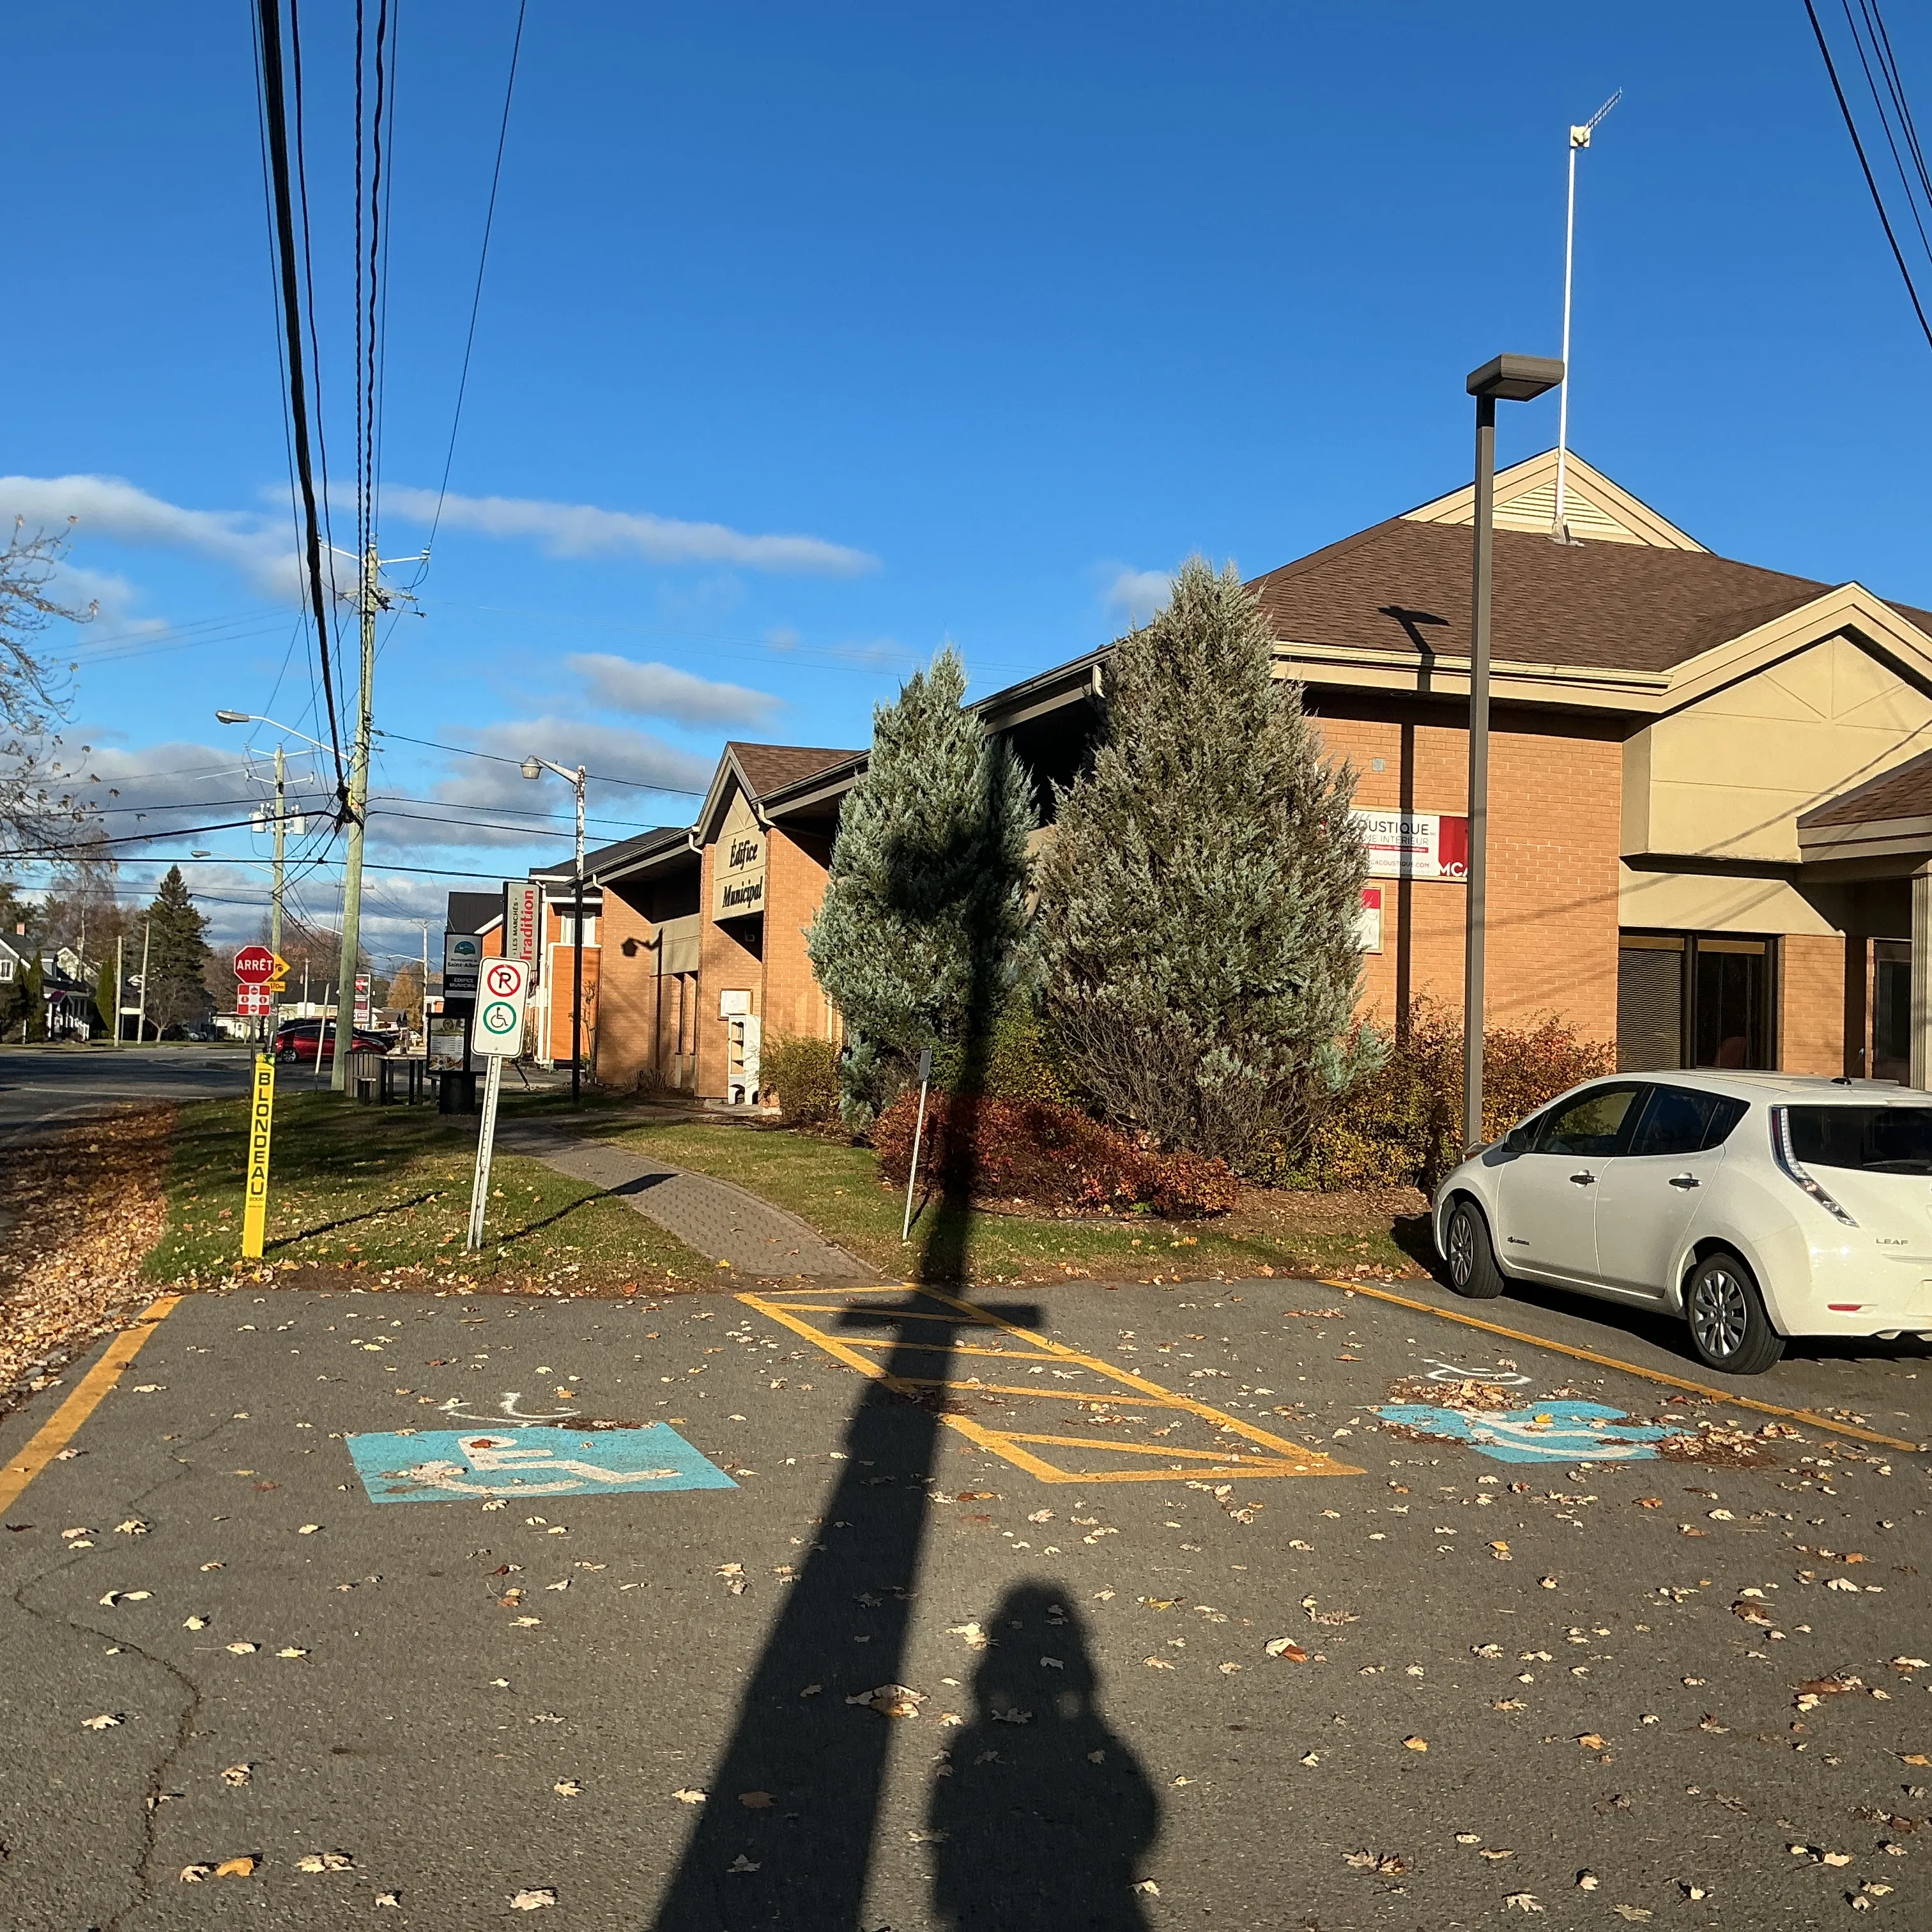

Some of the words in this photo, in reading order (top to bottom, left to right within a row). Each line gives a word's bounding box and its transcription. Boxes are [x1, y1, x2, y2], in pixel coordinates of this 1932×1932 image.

[729, 838, 758, 870] Édifice
[722, 875, 763, 908] Municipal
[519, 890, 534, 960] Tradition
[236, 958, 273, 971] ARRÊT
[250, 1072, 271, 1195] BLONDEAU
[1876, 1238, 1908, 1246] LEAF
